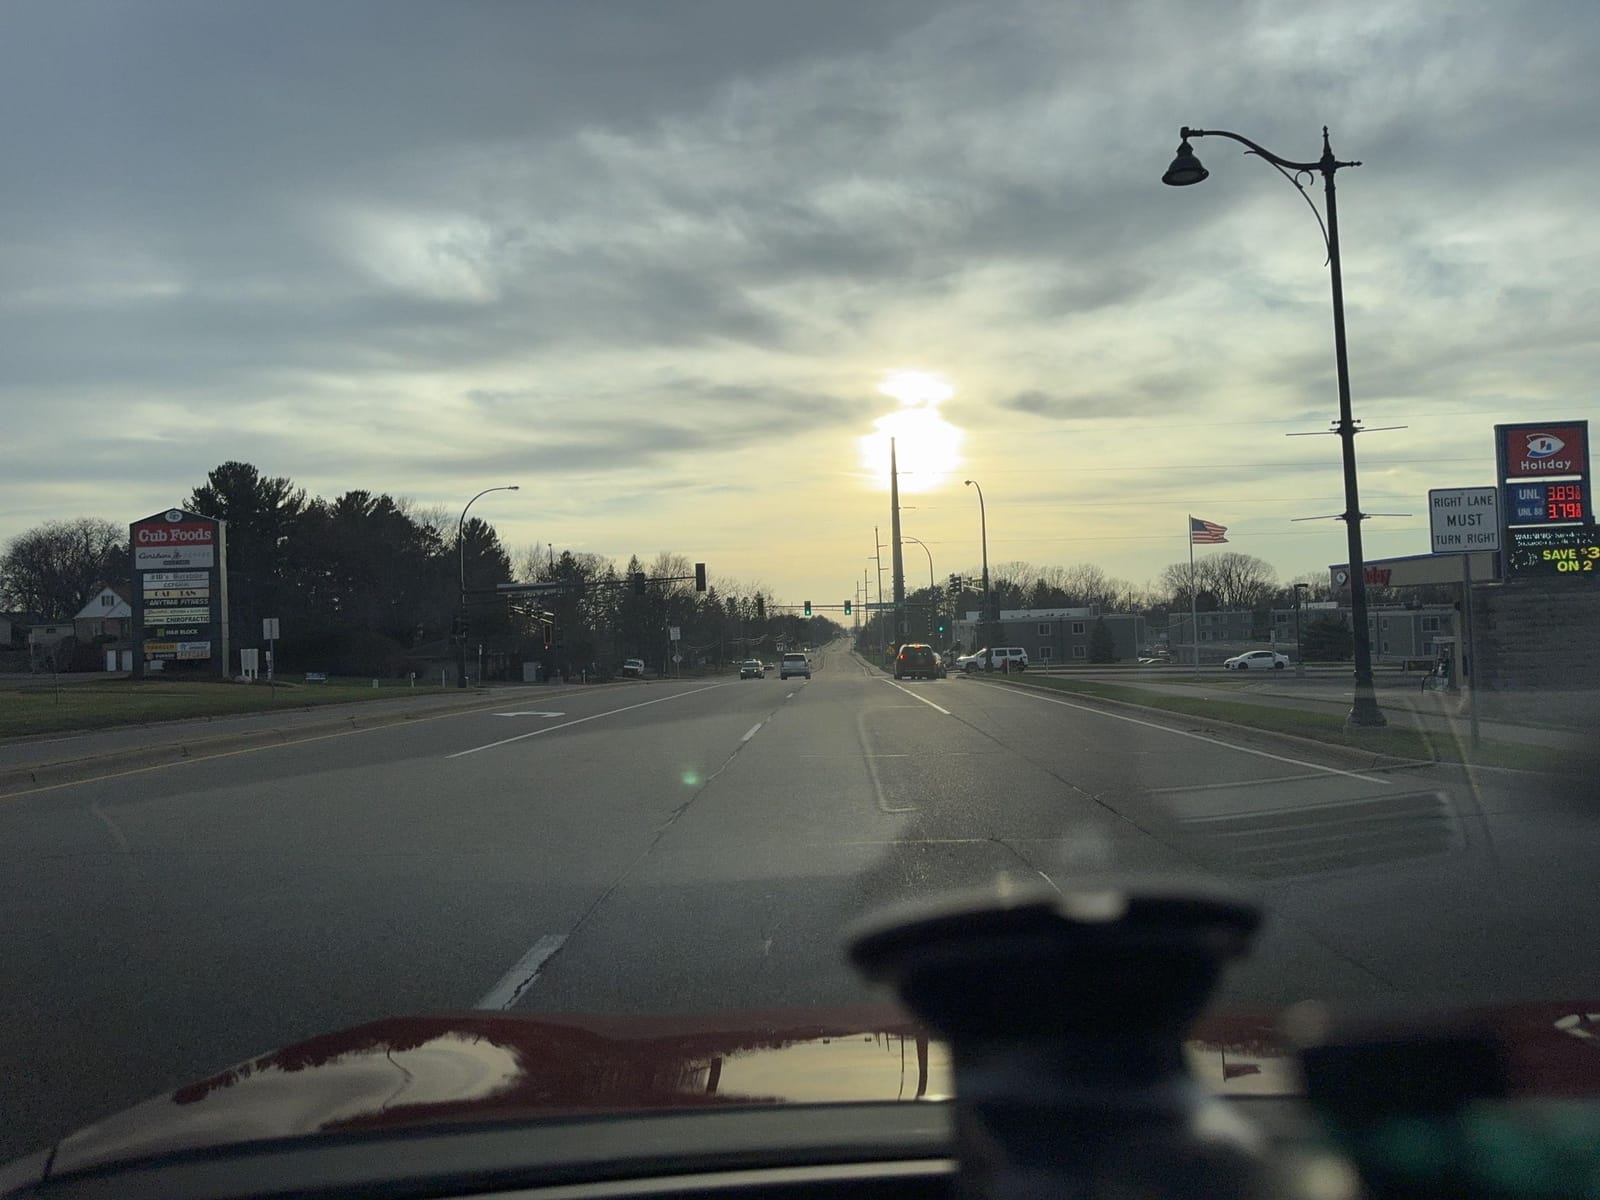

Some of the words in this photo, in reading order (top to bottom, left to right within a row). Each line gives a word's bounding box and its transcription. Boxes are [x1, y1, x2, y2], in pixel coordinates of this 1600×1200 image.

[1520, 459, 1571, 471] Holiday
[1519, 488, 1541, 500] UNL
[1434, 496, 1461, 508] RIGHT
[1467, 495, 1493, 506] LANE
[1447, 513, 1483, 527] MUST
[139, 529, 167, 542] Cub
[170, 528, 212, 542] Foods
[1435, 533, 1461, 545] TURN
[1467, 532, 1496, 544] RIGHT
[1542, 548, 1577, 560] SAVE
[1557, 560, 1580, 572] ON
[1583, 560, 1593, 571] 2
